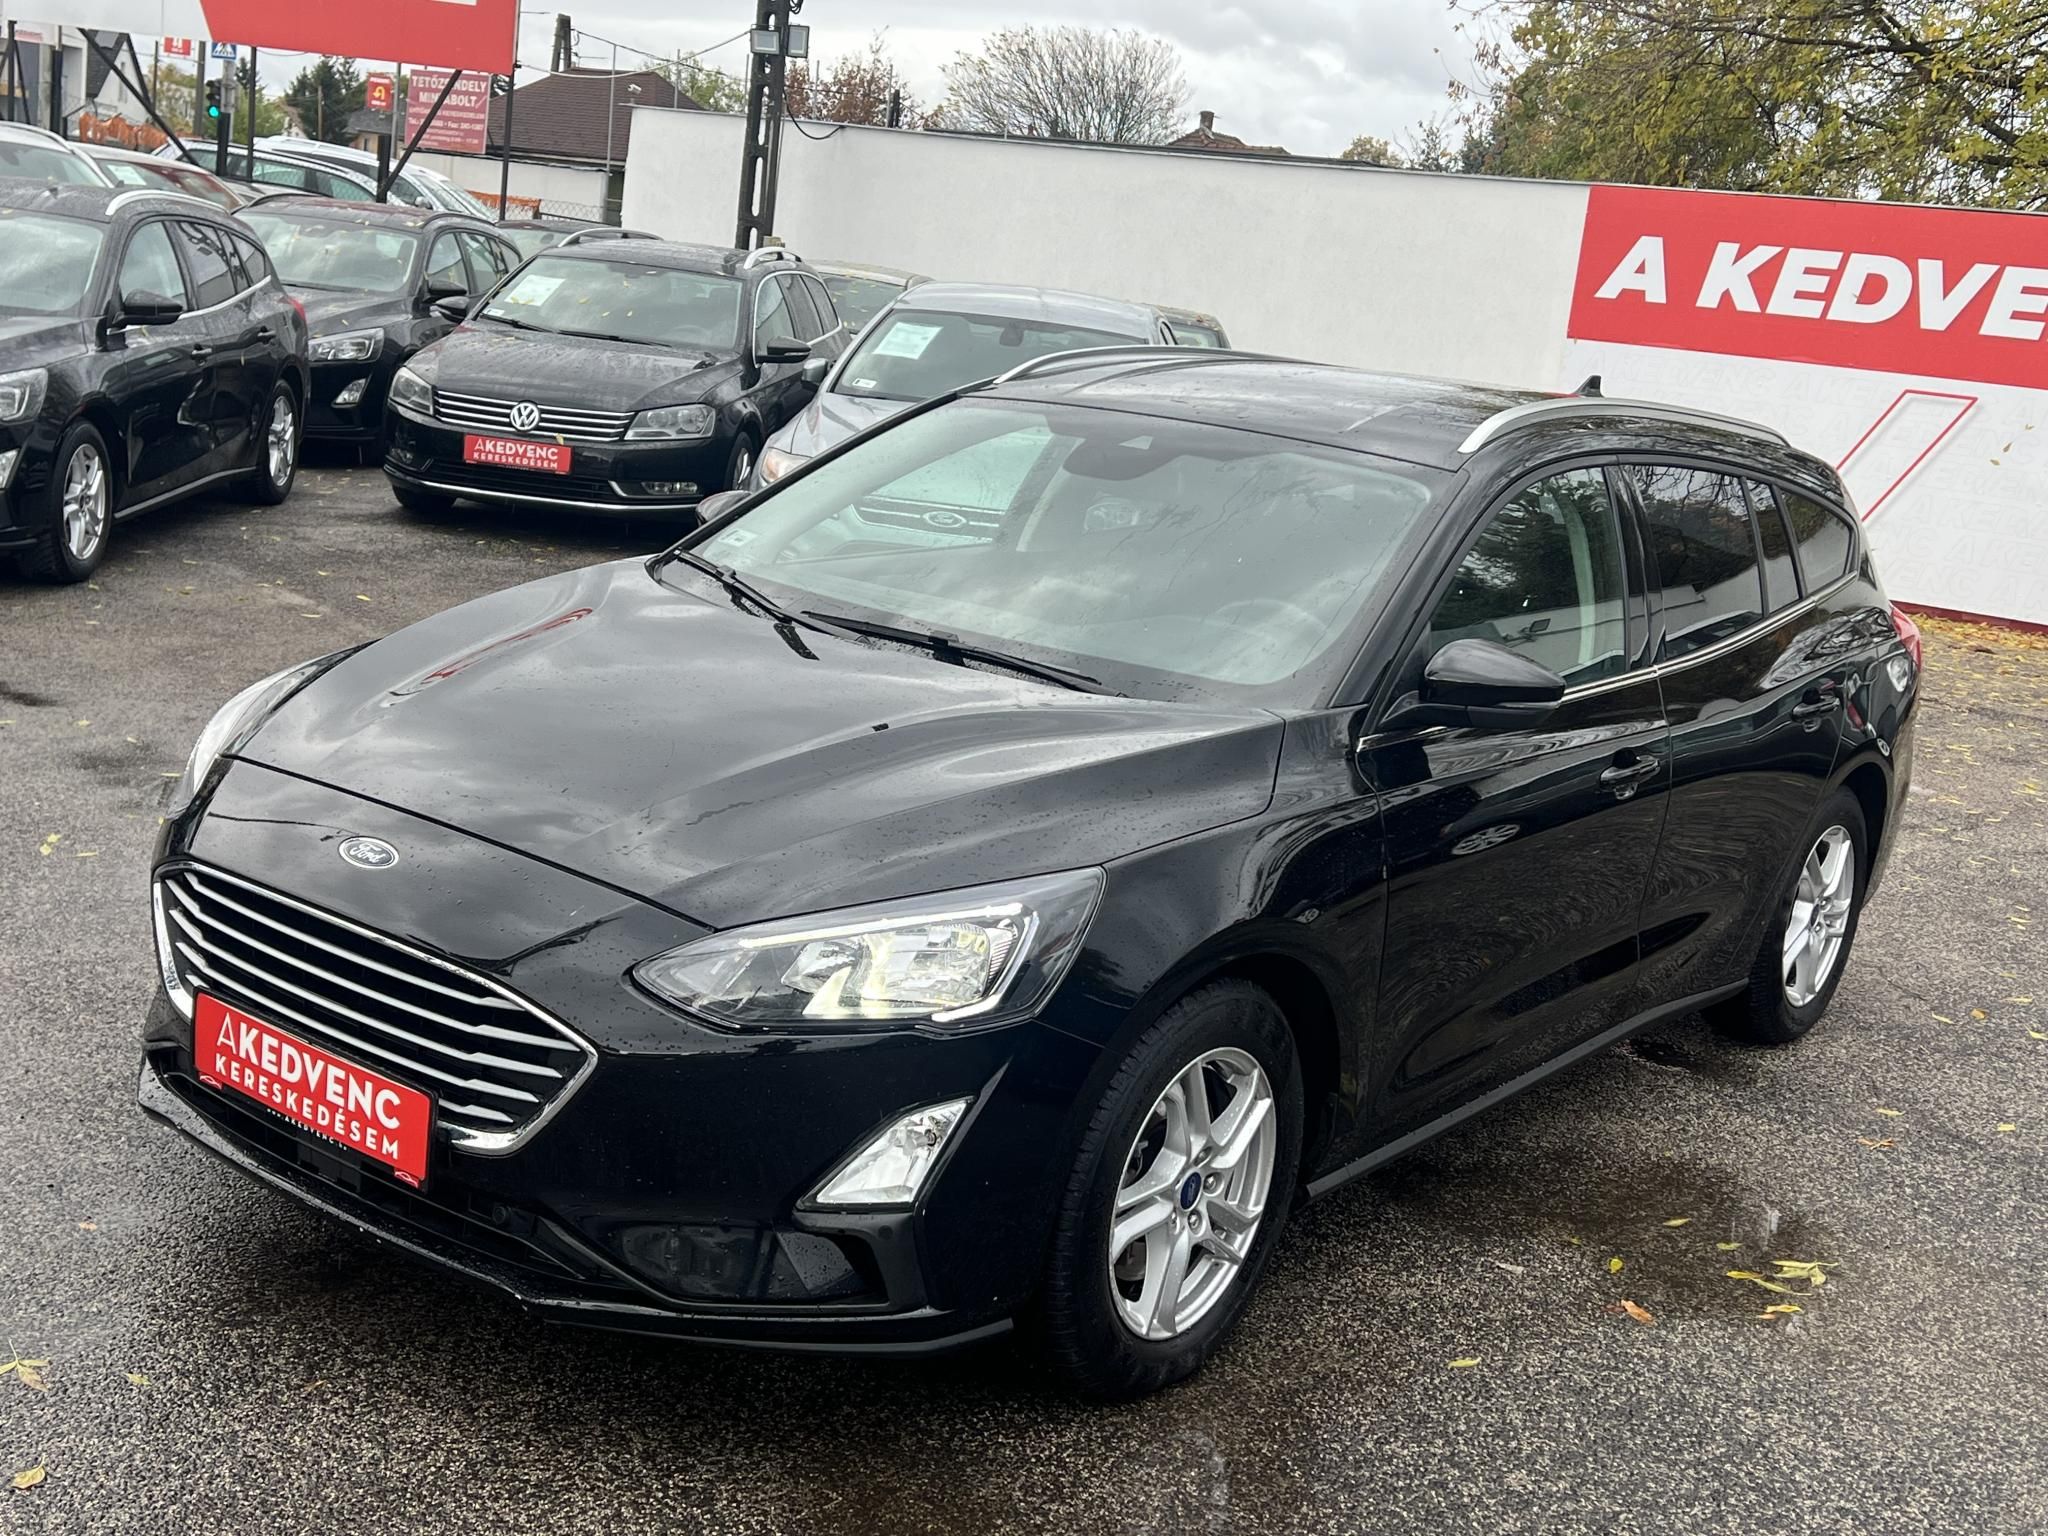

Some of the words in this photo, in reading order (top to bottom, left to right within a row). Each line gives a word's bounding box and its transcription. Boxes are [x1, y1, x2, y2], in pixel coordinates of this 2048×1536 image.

[411, 74, 487, 93] TETŐZNDELY
[418, 91, 477, 107] MINABOLT
[1594, 235, 1667, 304] A
[1695, 241, 2048, 342] KEDVE
[473, 452, 558, 469] KERESKEDÉSEM
[349, 843, 386, 863] Ford
[215, 1053, 399, 1160] KERESKEDÉSEM
